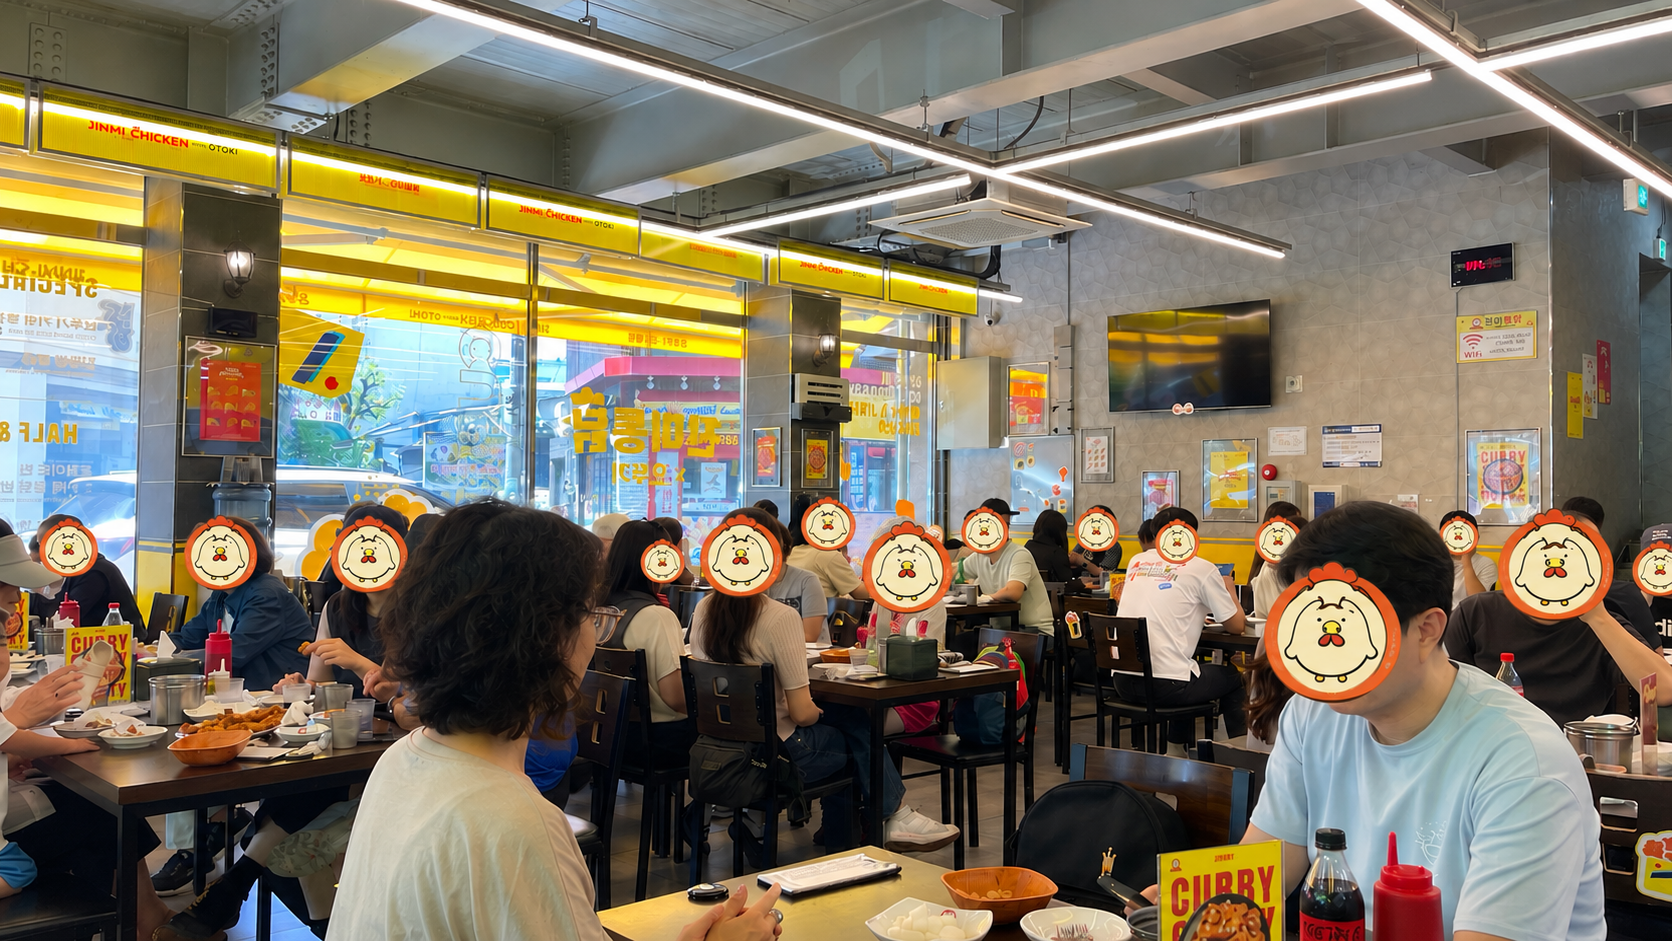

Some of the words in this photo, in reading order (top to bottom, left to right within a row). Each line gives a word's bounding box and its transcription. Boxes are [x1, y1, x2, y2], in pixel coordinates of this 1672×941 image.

[88, 120, 125, 136] JINMI
[208, 143, 238, 155] OTOKI
[71, 633, 128, 653] CURY
